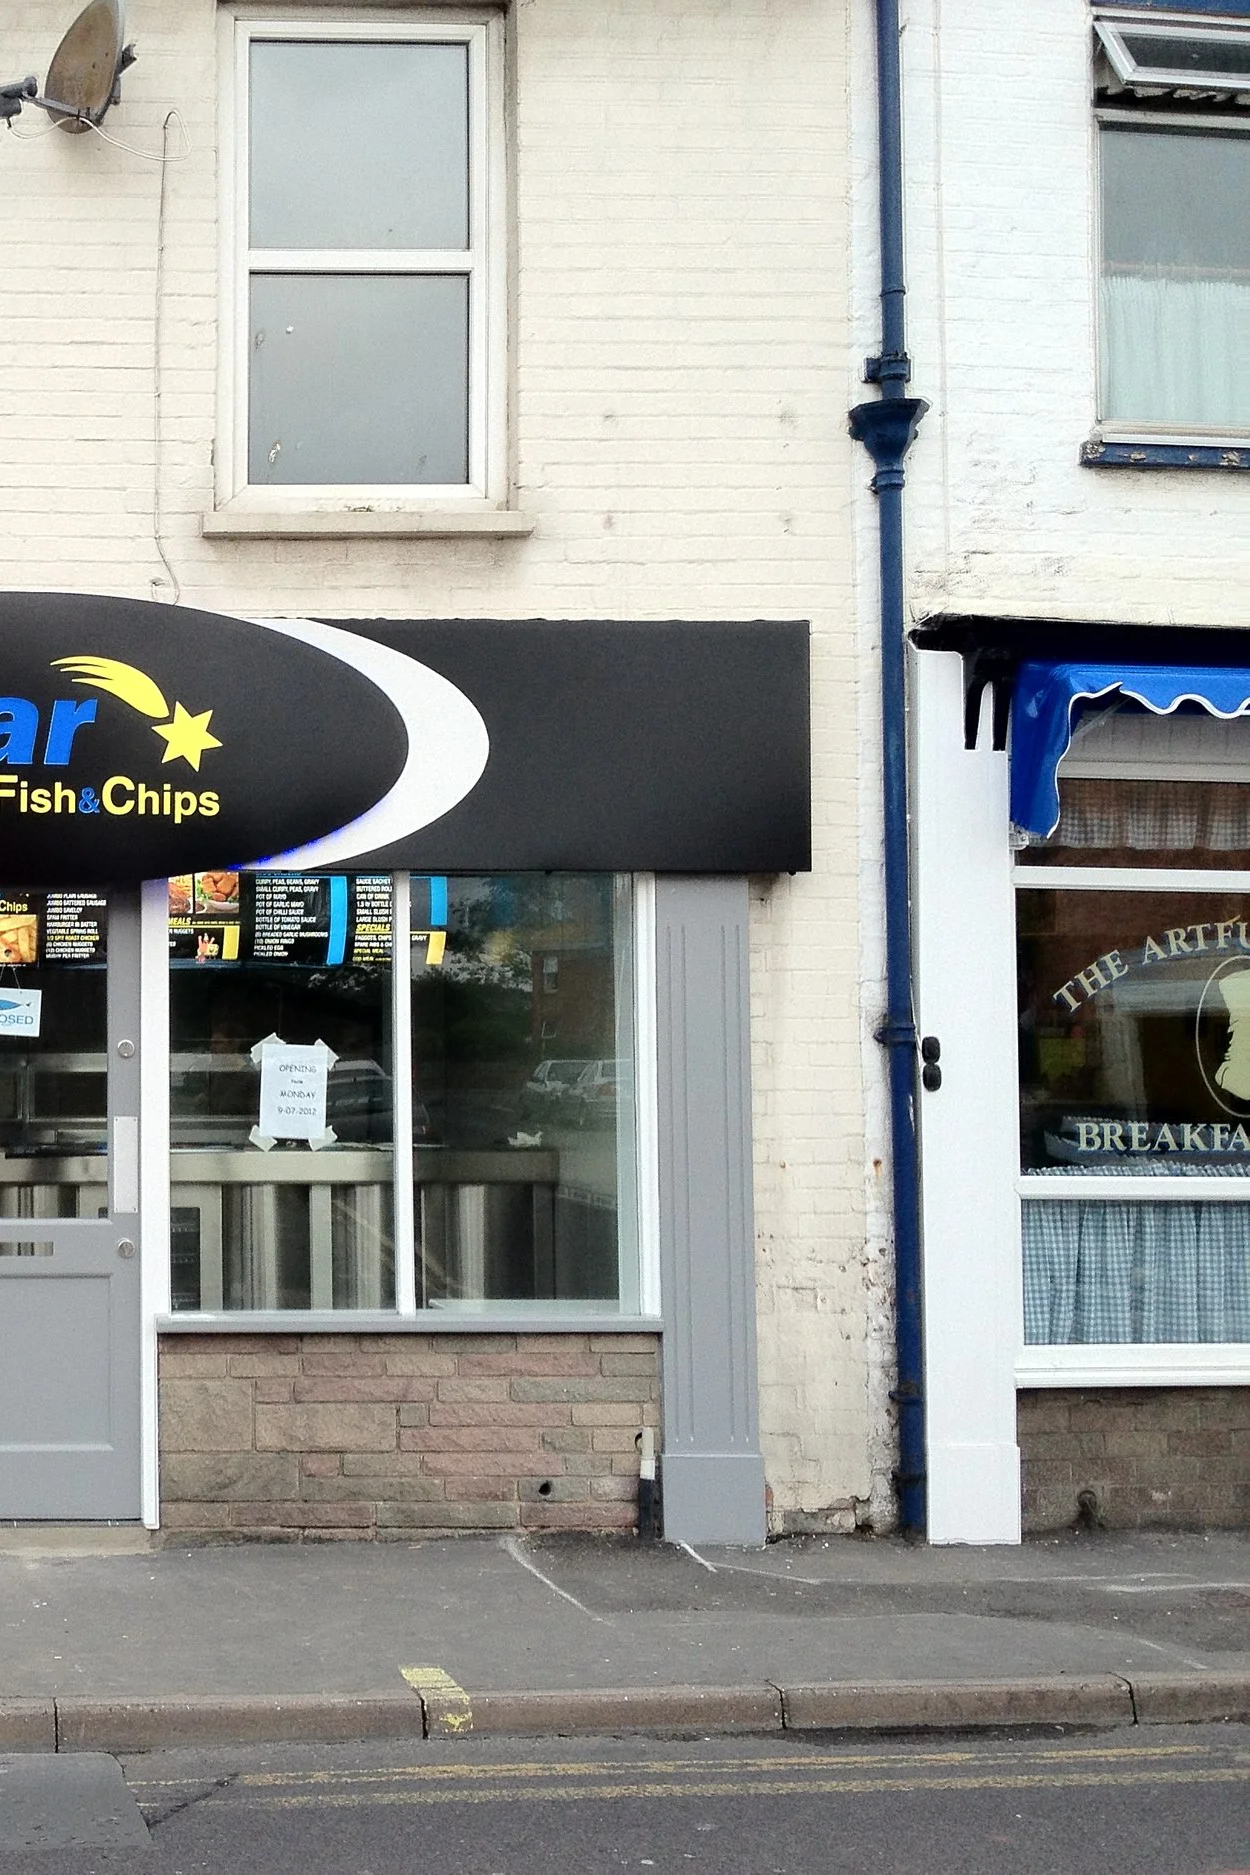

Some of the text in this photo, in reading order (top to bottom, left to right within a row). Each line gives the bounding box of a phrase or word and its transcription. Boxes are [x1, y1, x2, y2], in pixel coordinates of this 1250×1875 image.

[1052, 949, 1129, 1013] THE
[279, 1064, 317, 1073] OPENING
[279, 1090, 316, 1099] MONDAY
[1076, 1122, 1250, 1151] BREAKFA
